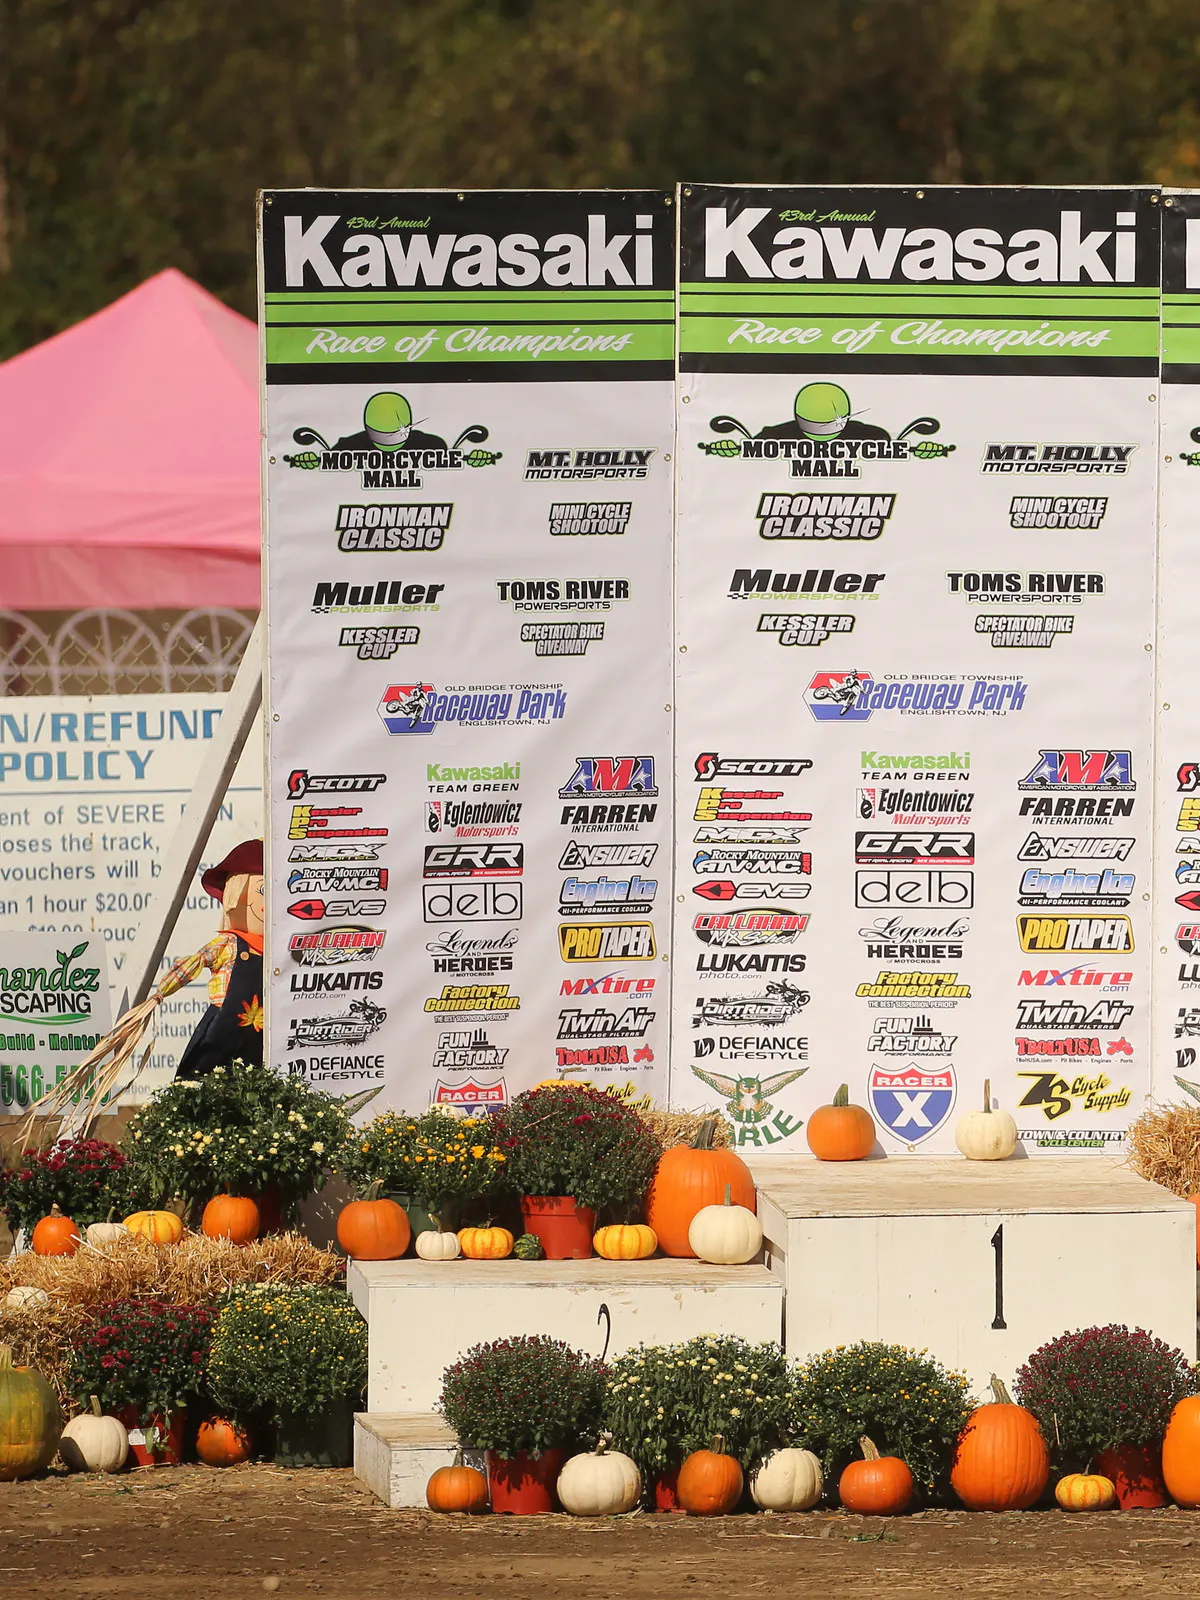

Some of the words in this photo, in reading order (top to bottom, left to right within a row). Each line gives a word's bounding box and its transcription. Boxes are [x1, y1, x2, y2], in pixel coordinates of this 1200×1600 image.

[348, 216, 377, 228] 43rd
[380, 216, 429, 229] Annual
[779, 210, 814, 221] 43rd
[818, 209, 876, 222] Annual
[284, 215, 652, 287] Kawasaki
[705, 207, 1136, 282] Kawasaki
[305, 329, 388, 354] Race
[394, 329, 437, 361] of
[444, 327, 633, 357] Champions
[726, 320, 824, 344] Race
[832, 321, 882, 353] of
[890, 321, 1112, 352] Champions
[743, 441, 908, 458] MOTORCYCLE
[1041, 445, 1134, 461] HOLLY
[322, 451, 462, 469] MOTORCYCLE
[791, 460, 859, 477] MALL
[982, 463, 1127, 474] MOTORSPORTS
[363, 470, 421, 488] MALL
[760, 496, 892, 516] IRONMAN
[1012, 498, 1052, 512] MINI
[1054, 499, 1106, 514] CYCLE
[339, 507, 450, 528] IRONMAN
[1012, 512, 1100, 528] SHOOTOUT
[764, 518, 882, 537] CLASSIC
[342, 529, 442, 548] CLASSIC
[730, 570, 886, 593] Muller
[948, 572, 1021, 593] TOMS
[1024, 573, 1104, 594] RIVER
[314, 582, 445, 606] Muller
[497, 581, 559, 602] TOMS
[562, 580, 629, 600] RIVER
[968, 594, 1082, 603] POWERSPORTS
[759, 616, 854, 630] KESSLER
[976, 616, 1044, 632] SPECTATOR
[1044, 617, 1072, 633] BIKE
[781, 630, 828, 646] CUP
[992, 632, 1055, 647] GIVEAWAY
[856, 681, 965, 712] Raceway
[968, 682, 1028, 711] Park
[422, 692, 514, 723] Raceway
[516, 691, 566, 720] Park
[0, 750, 154, 781] POLICY
[717, 762, 807, 773] SCOTT
[861, 751, 970, 769] Kawasaki
[1018, 750, 1136, 785] AMA
[862, 772, 907, 780] TEAM
[914, 772, 970, 780] GREEN
[697, 800, 742, 810] Pro
[878, 788, 974, 814] Eglentowicz
[1019, 798, 1135, 816] FARREN
[44, 806, 64, 825] of
[77, 804, 165, 824] SEVERE
[560, 805, 657, 823] FARREN
[892, 814, 970, 826] Motorsports
[61, 833, 93, 852] the
[102, 832, 160, 853] track,
[857, 834, 972, 856] GRR
[712, 850, 744, 860] ROCKY
[746, 850, 801, 860] MOUNTAIN
[1, 862, 95, 881] vouchers
[107, 860, 139, 879] will
[861, 871, 968, 903] delb
[1020, 868, 1100, 898] Engine
[1099, 869, 1135, 895] Ice
[44, 895, 88, 912] hour
[695, 914, 808, 931] CALLAHAN
[858, 916, 970, 944] Legends
[745, 931, 799, 944] School
[867, 945, 962, 958] HEROES
[876, 972, 958, 984] Factory
[874, 1018, 912, 1034] FUN
[720, 1037, 808, 1050] DEFIANCE
[868, 1036, 958, 1052] FACTORY
[311, 1057, 384, 1070] DEFIANCE
[720, 1052, 808, 1060] LIFESTYLE
[877, 1077, 947, 1086] RACER
[1071, 1075, 1109, 1095] Cycle
[1084, 1088, 1130, 1111] Supply
[891, 1092, 933, 1127] X
[1067, 1140, 1104, 1148] CENTER
[990, 1223, 1007, 1330] 1
